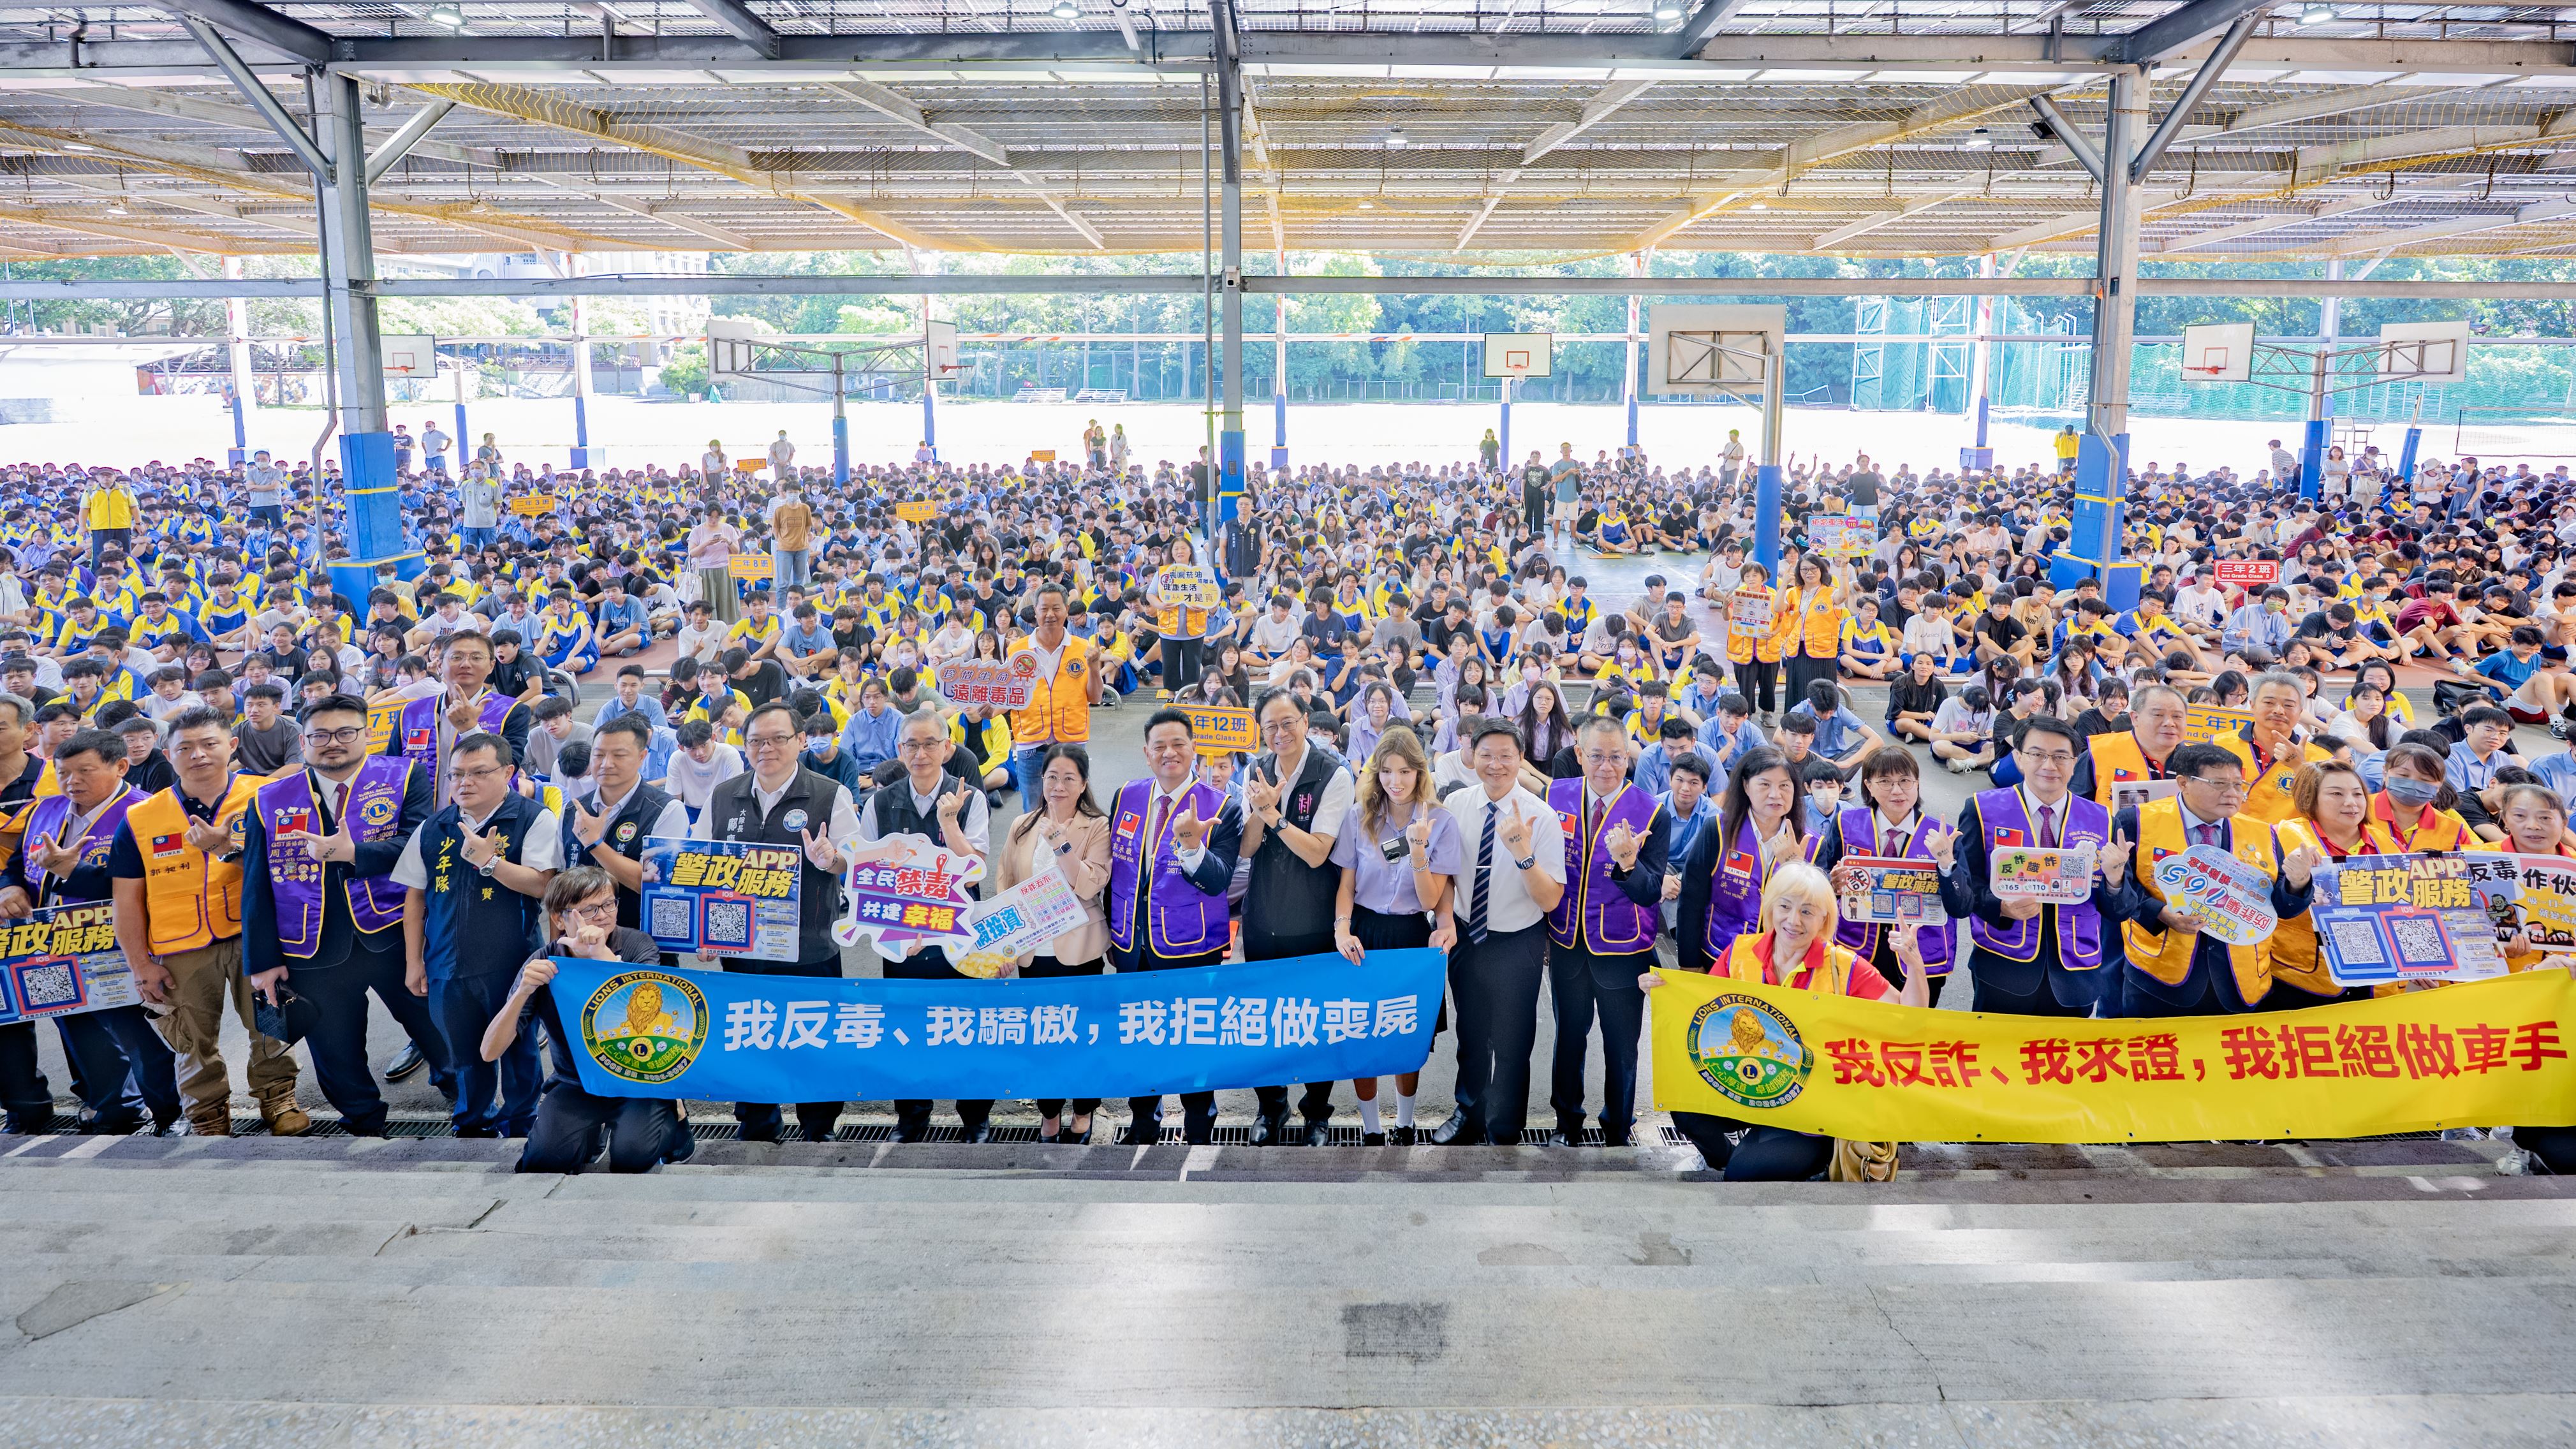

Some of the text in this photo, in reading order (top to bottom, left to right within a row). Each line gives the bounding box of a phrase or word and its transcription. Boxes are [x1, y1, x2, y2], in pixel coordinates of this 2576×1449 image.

[2221, 564, 2271, 573] 三年2班
[941, 668, 1009, 682] 珍惜生命
[952, 683, 1026, 705] 遠離毒品
[1216, 733, 1236, 742] Class
[436, 836, 455, 893] 少年隊
[743, 850, 798, 870] APP
[1728, 868, 1747, 877] TAIWAN
[2001, 855, 2057, 873] 反詐識詐
[2410, 858, 2467, 879] APP
[670, 851, 795, 898] 警政服務
[857, 856, 952, 900] 全民禁毒
[1847, 871, 1867, 890] 詐
[1881, 873, 1939, 894] 警政服務
[2158, 865, 2227, 905] 165
[2339, 867, 2471, 909] 警政服務
[52, 906, 114, 930] APP
[862, 901, 955, 930] 共建幸福
[2225, 897, 2272, 930] 防詐騙
[588, 972, 702, 1011] LIONS INTERNATIONAL
[724, 994, 1418, 1052] 我反毒、我驕傲，我拒絕做喪屍
[1693, 994, 1799, 1041] LIONS INTERNATIONAL
[605, 1043, 683, 1070] 仁心厚道 卓越服務
[637, 1045, 645, 1057] L
[1825, 1020, 2568, 1088] 我反詐、我求證，我拒絕做車手
[1709, 1062, 1792, 1095] 仁心厚道 卓越服務
[1746, 1066, 1755, 1078] L
